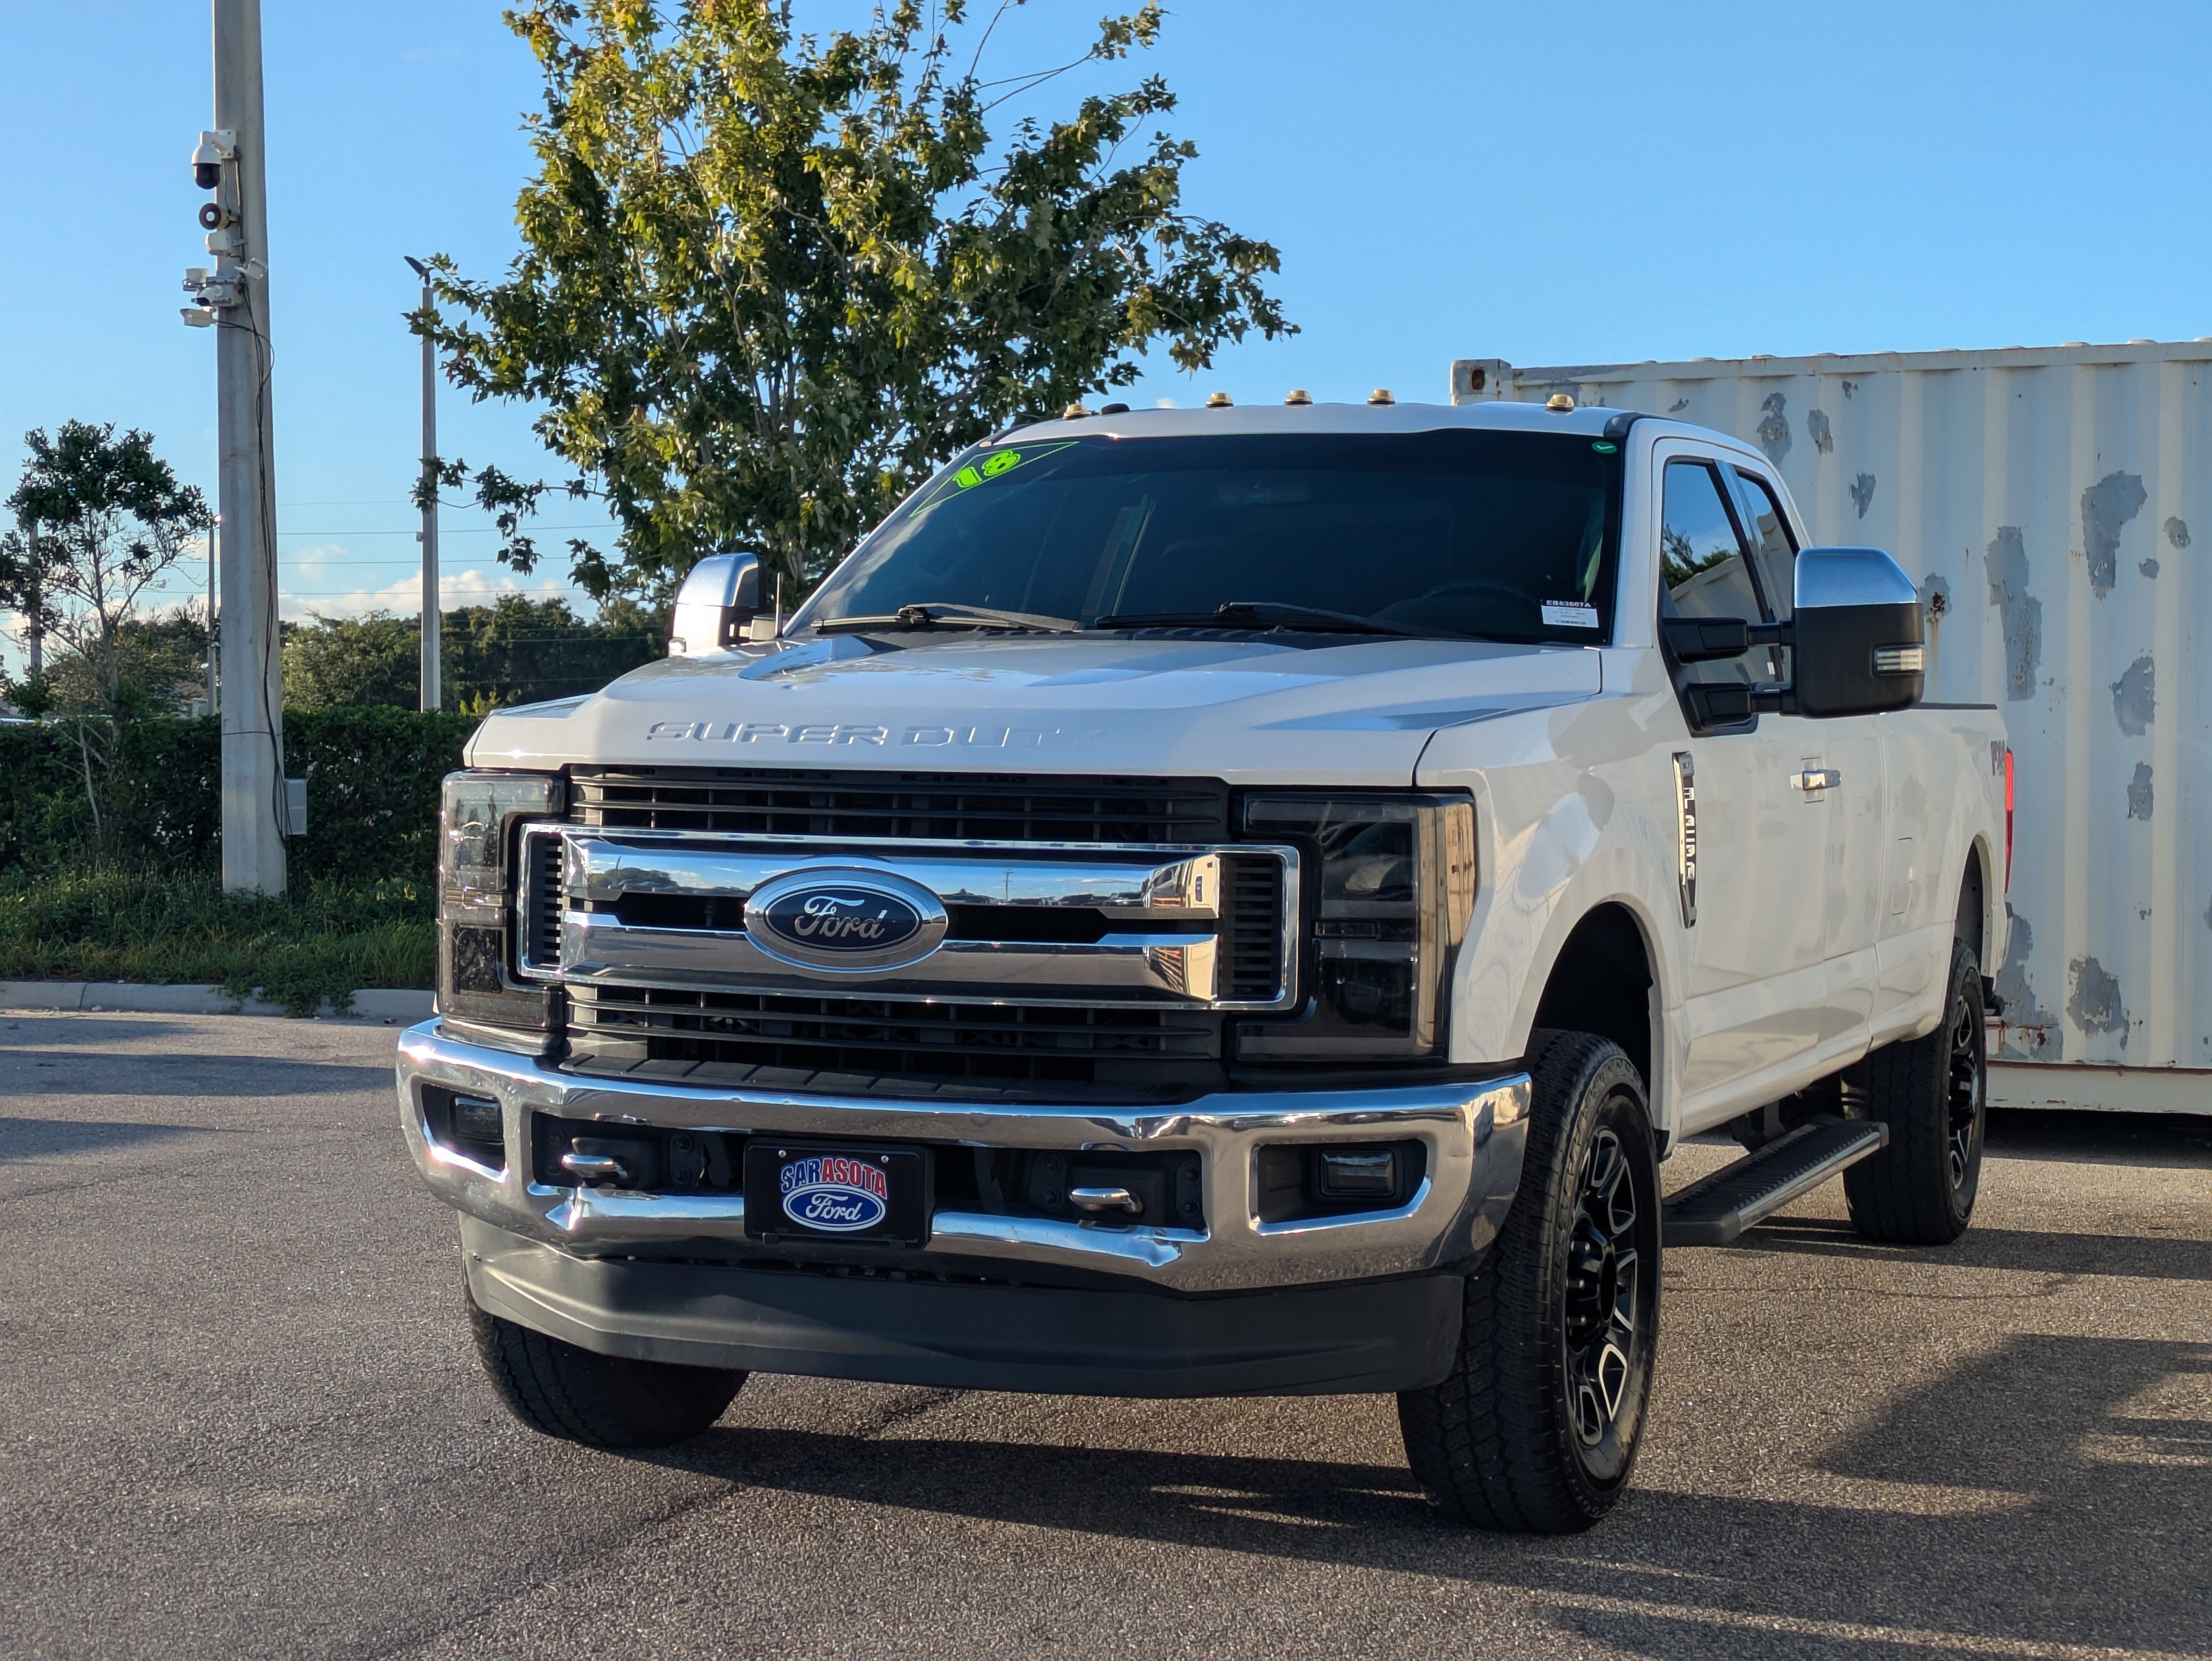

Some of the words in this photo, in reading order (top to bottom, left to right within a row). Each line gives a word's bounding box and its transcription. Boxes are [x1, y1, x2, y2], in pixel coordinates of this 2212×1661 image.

[952, 450, 1021, 488] 18
[647, 721, 889, 747] SUPER
[794, 896, 888, 939] Ford
[781, 1156, 888, 1200] SARASOTA
[806, 1193, 863, 1221] Ford
